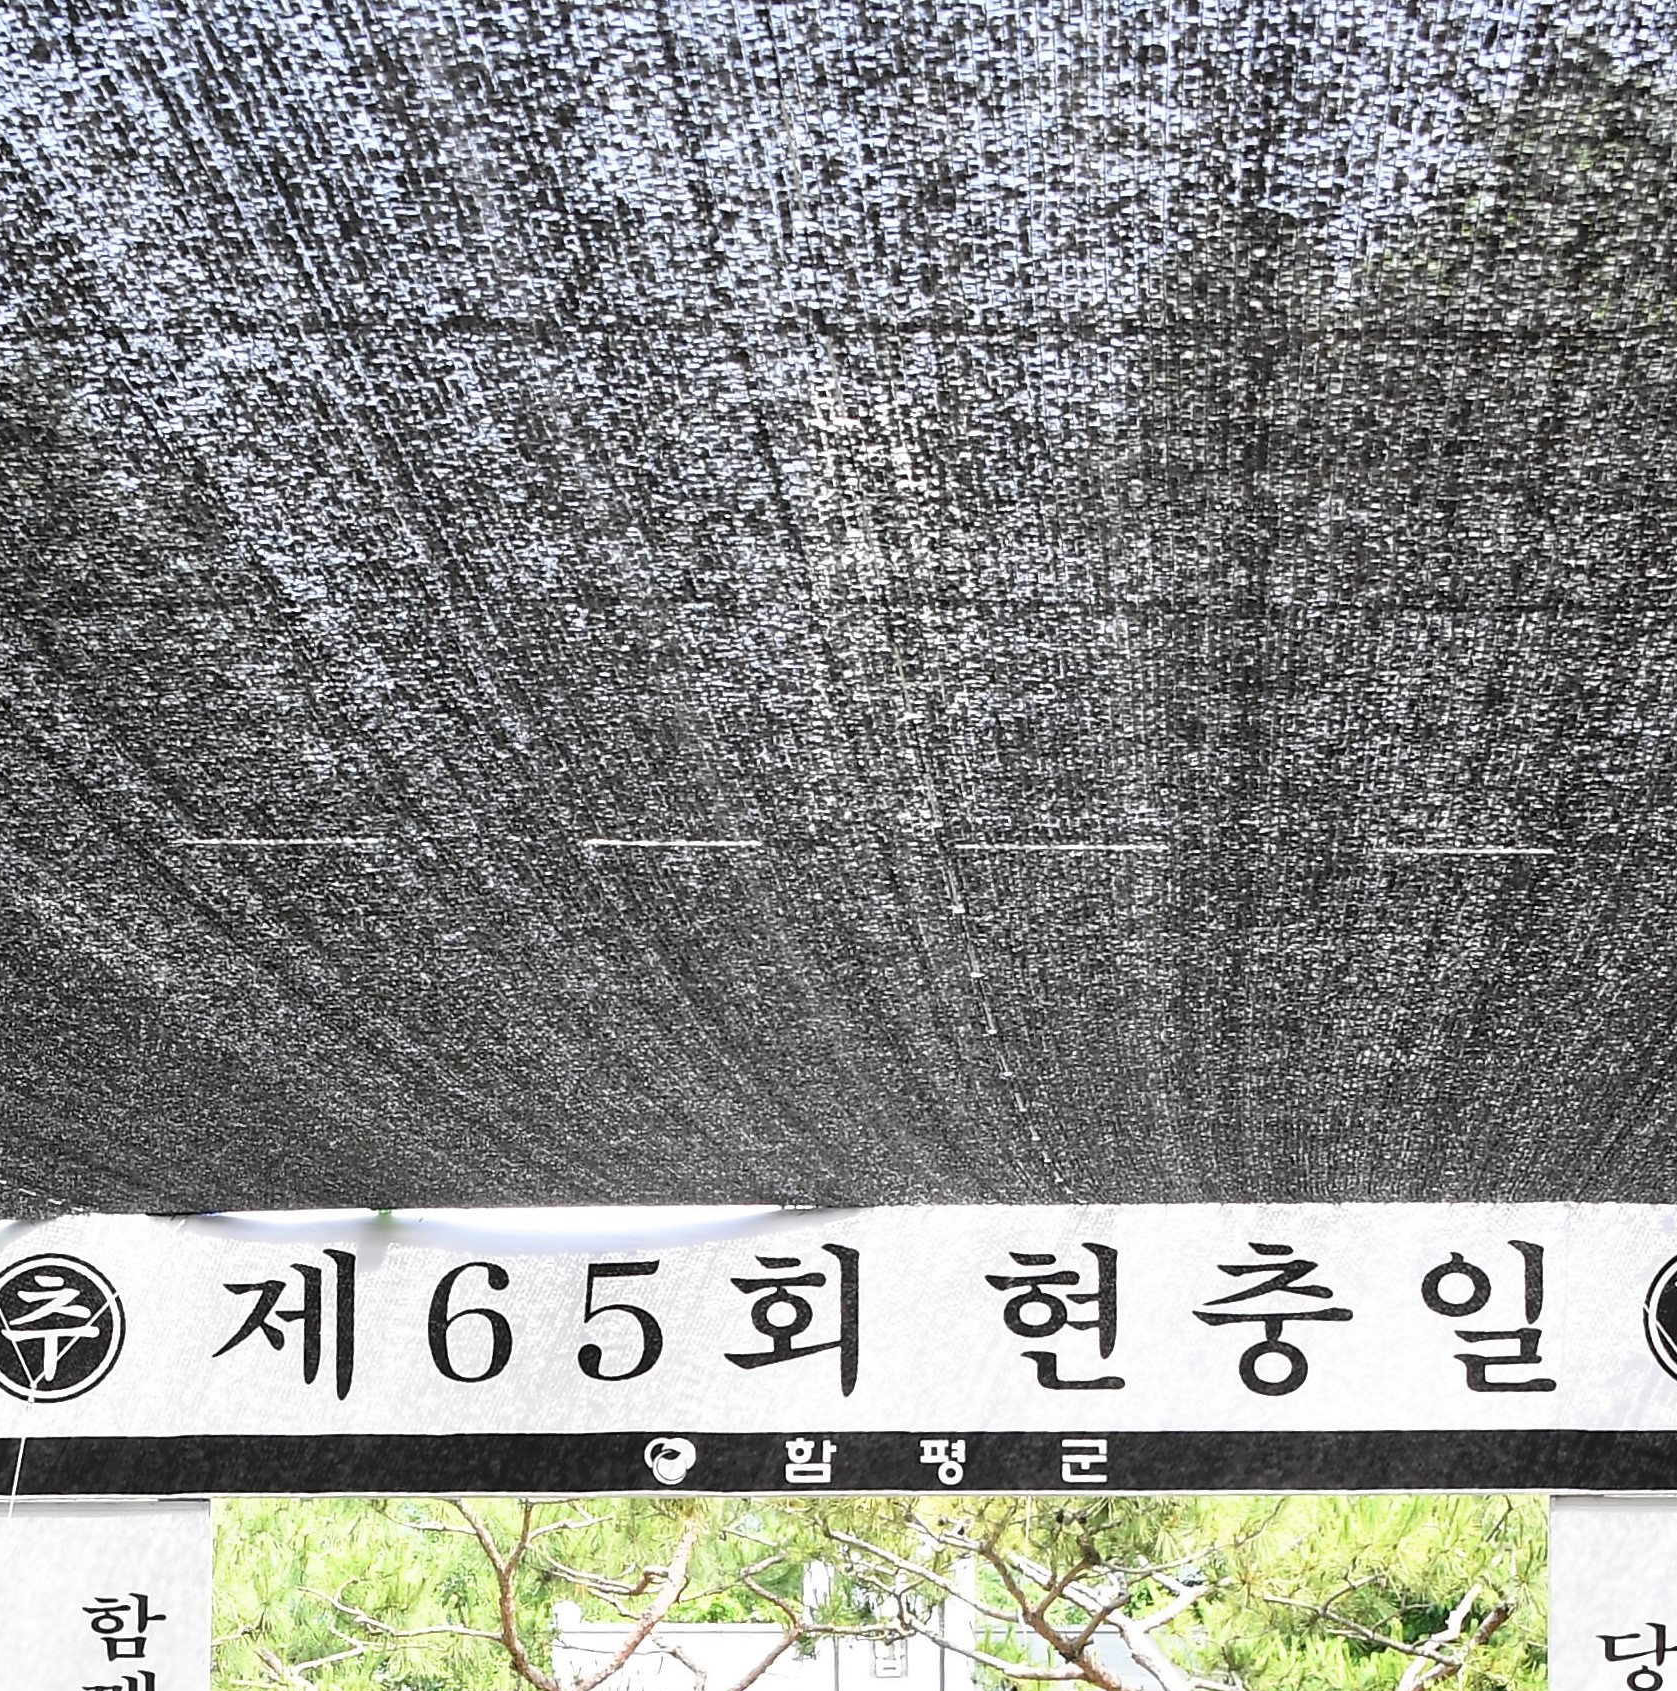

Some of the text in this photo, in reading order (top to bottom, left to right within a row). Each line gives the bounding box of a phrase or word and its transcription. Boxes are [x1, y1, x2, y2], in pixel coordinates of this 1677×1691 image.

[212, 1242, 862, 1403] 제65회
[981, 1238, 1559, 1398] 현충일
[782, 1436, 1110, 1486] 함평군
